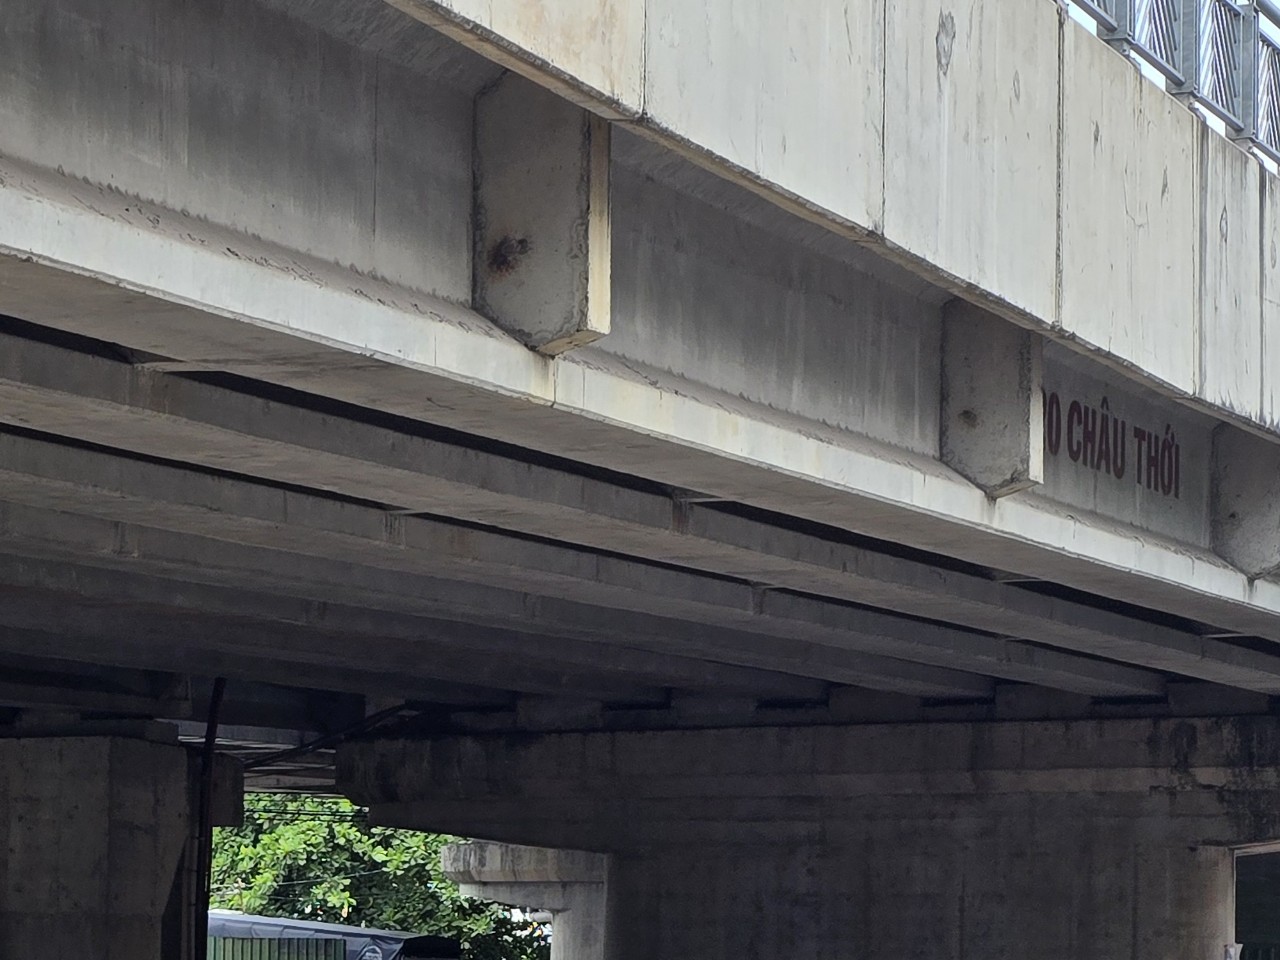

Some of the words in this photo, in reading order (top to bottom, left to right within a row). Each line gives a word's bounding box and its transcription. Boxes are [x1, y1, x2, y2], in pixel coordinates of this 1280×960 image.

[1042, 385, 1062, 457] O
[1067, 396, 1126, 479] CHÂU
[1133, 423, 1180, 499] THỚI
